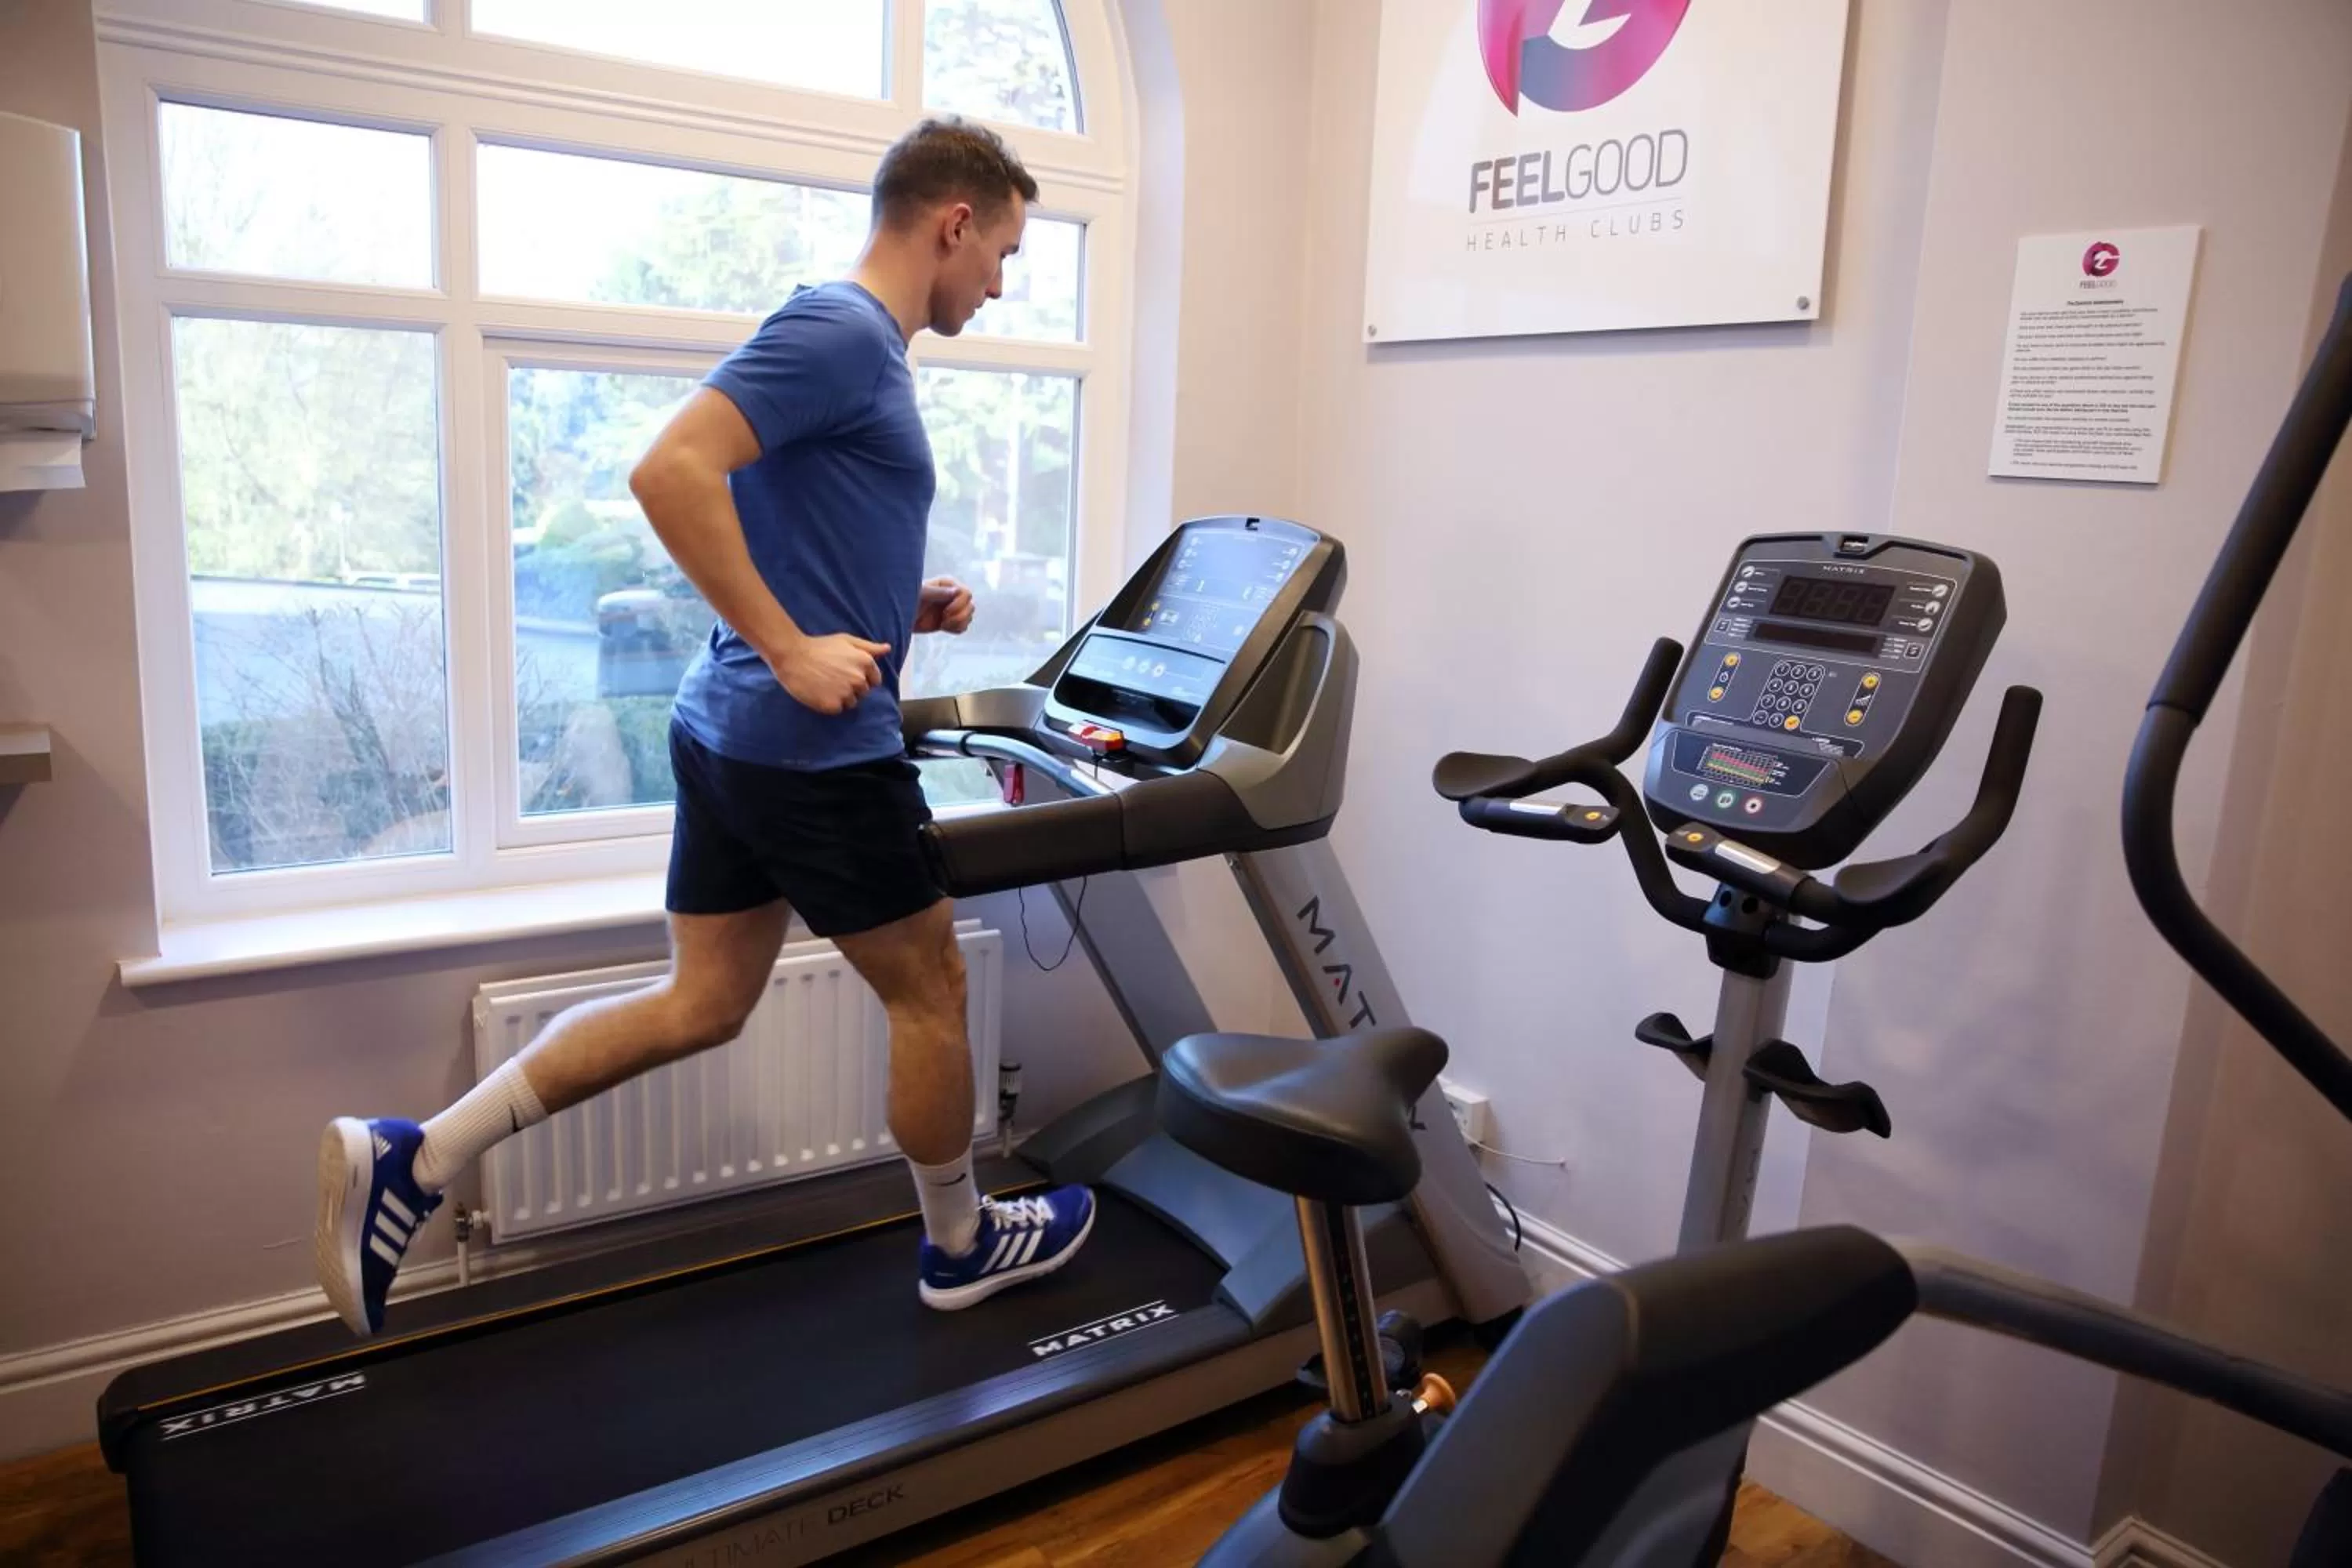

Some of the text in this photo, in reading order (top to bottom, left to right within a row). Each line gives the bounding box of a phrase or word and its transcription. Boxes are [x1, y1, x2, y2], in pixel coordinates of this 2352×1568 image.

[1468, 129, 1689, 213] FEELGOOD
[1466, 209, 1684, 251] HEALTH CLUBS
[1032, 1303, 1174, 1357] MATRIX
[160, 1374, 365, 1435] MATRIX
[826, 1483, 905, 1526] DECK
